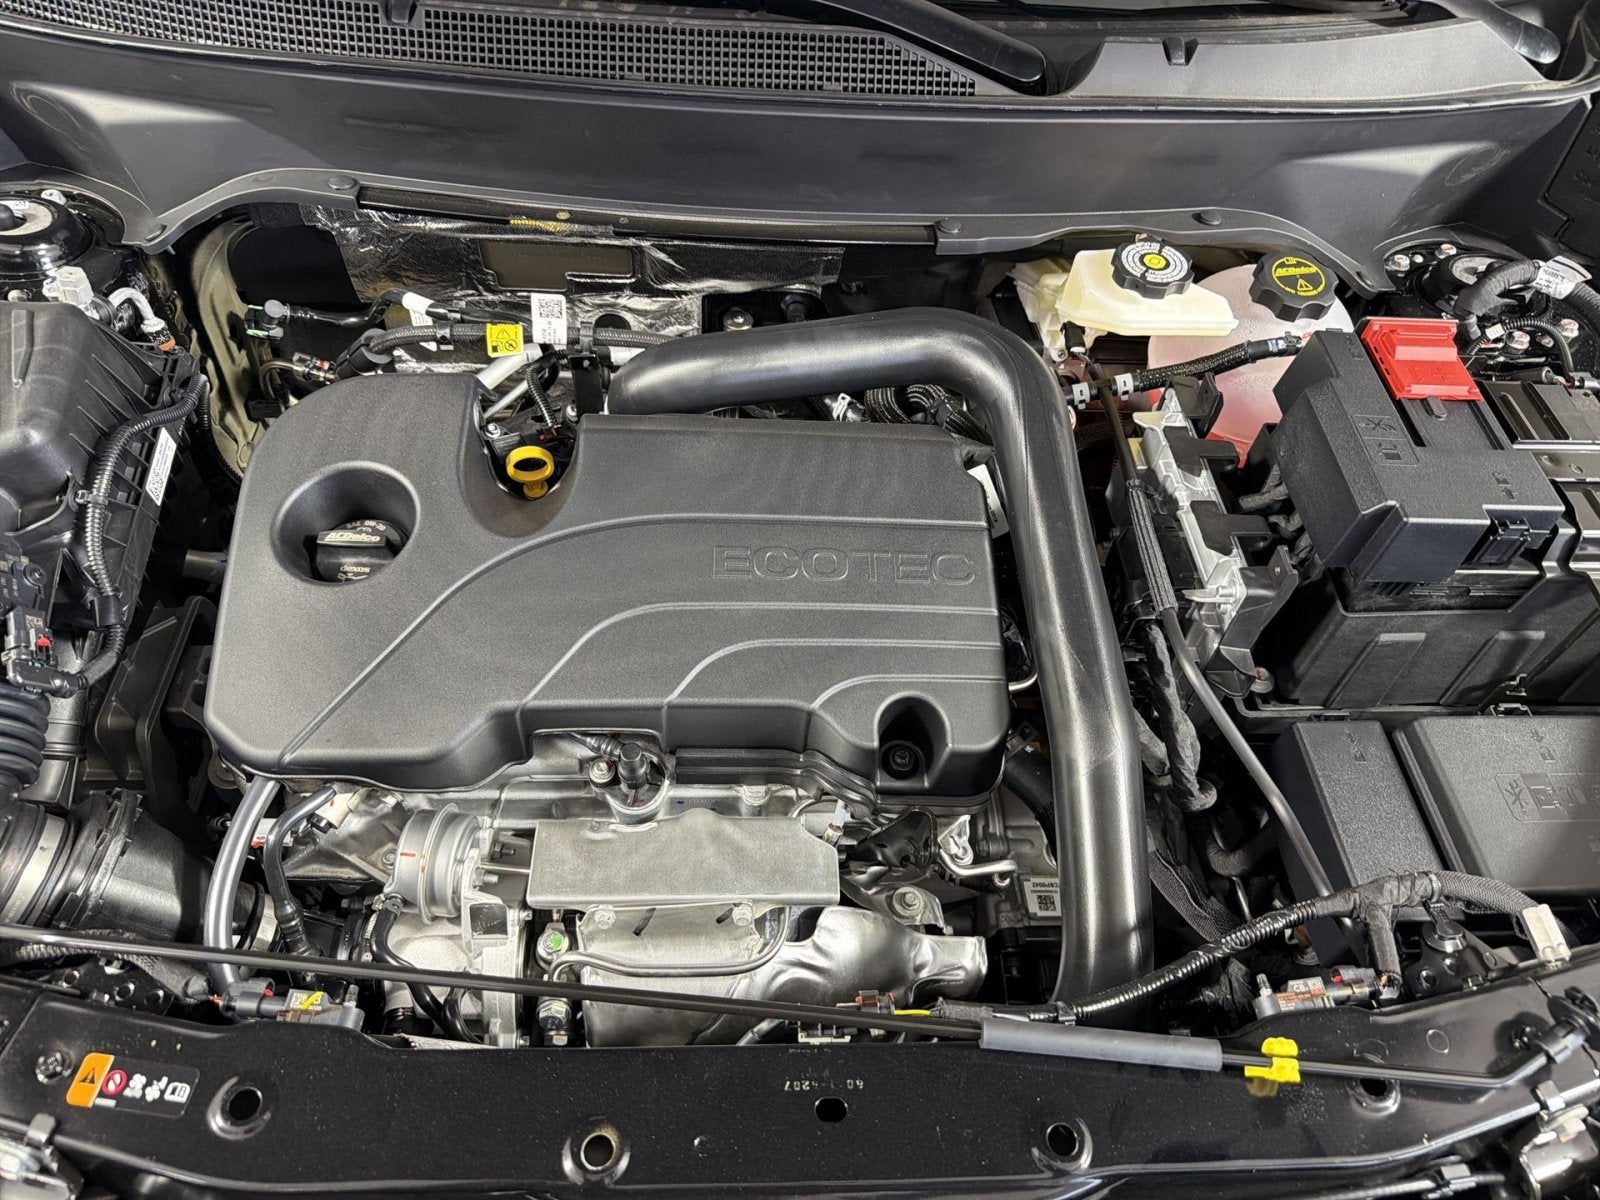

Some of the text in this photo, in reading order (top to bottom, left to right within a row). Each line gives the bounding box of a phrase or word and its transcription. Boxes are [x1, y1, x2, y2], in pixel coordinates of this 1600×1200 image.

[1275, 265, 1317, 276] ACDelco
[323, 532, 381, 542] ACDelco
[712, 545, 976, 586] ECOTEC
